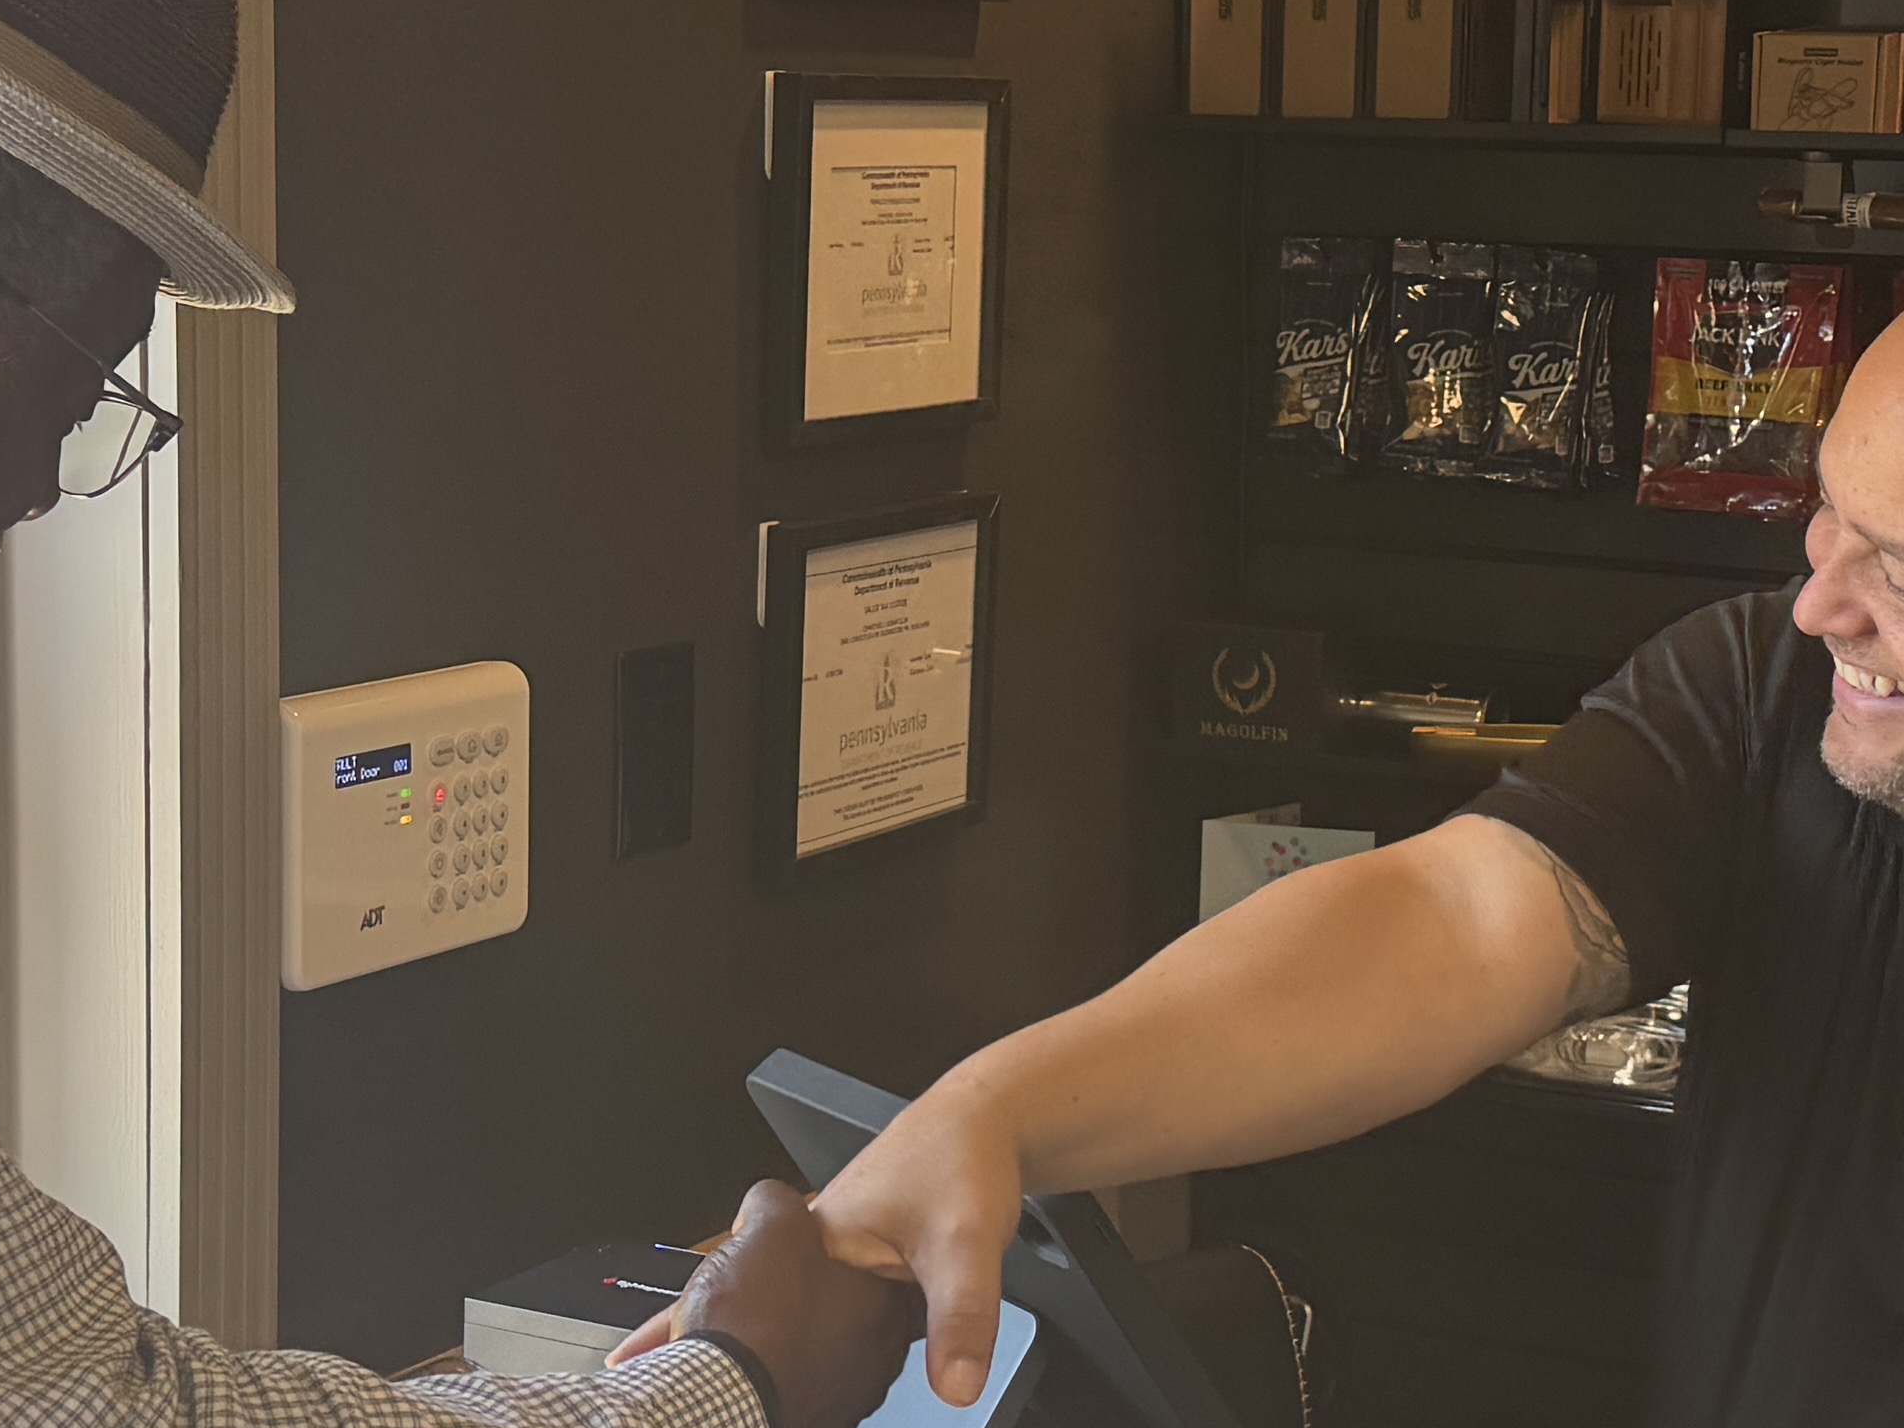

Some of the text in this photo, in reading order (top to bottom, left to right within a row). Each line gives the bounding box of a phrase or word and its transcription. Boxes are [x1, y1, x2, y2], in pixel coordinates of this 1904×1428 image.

[1276, 327, 1348, 366] Kar's
[840, 709, 928, 756] pennsylvania
[1200, 719, 1289, 742] MAGOLFIN
[360, 905, 385, 932] ADT
